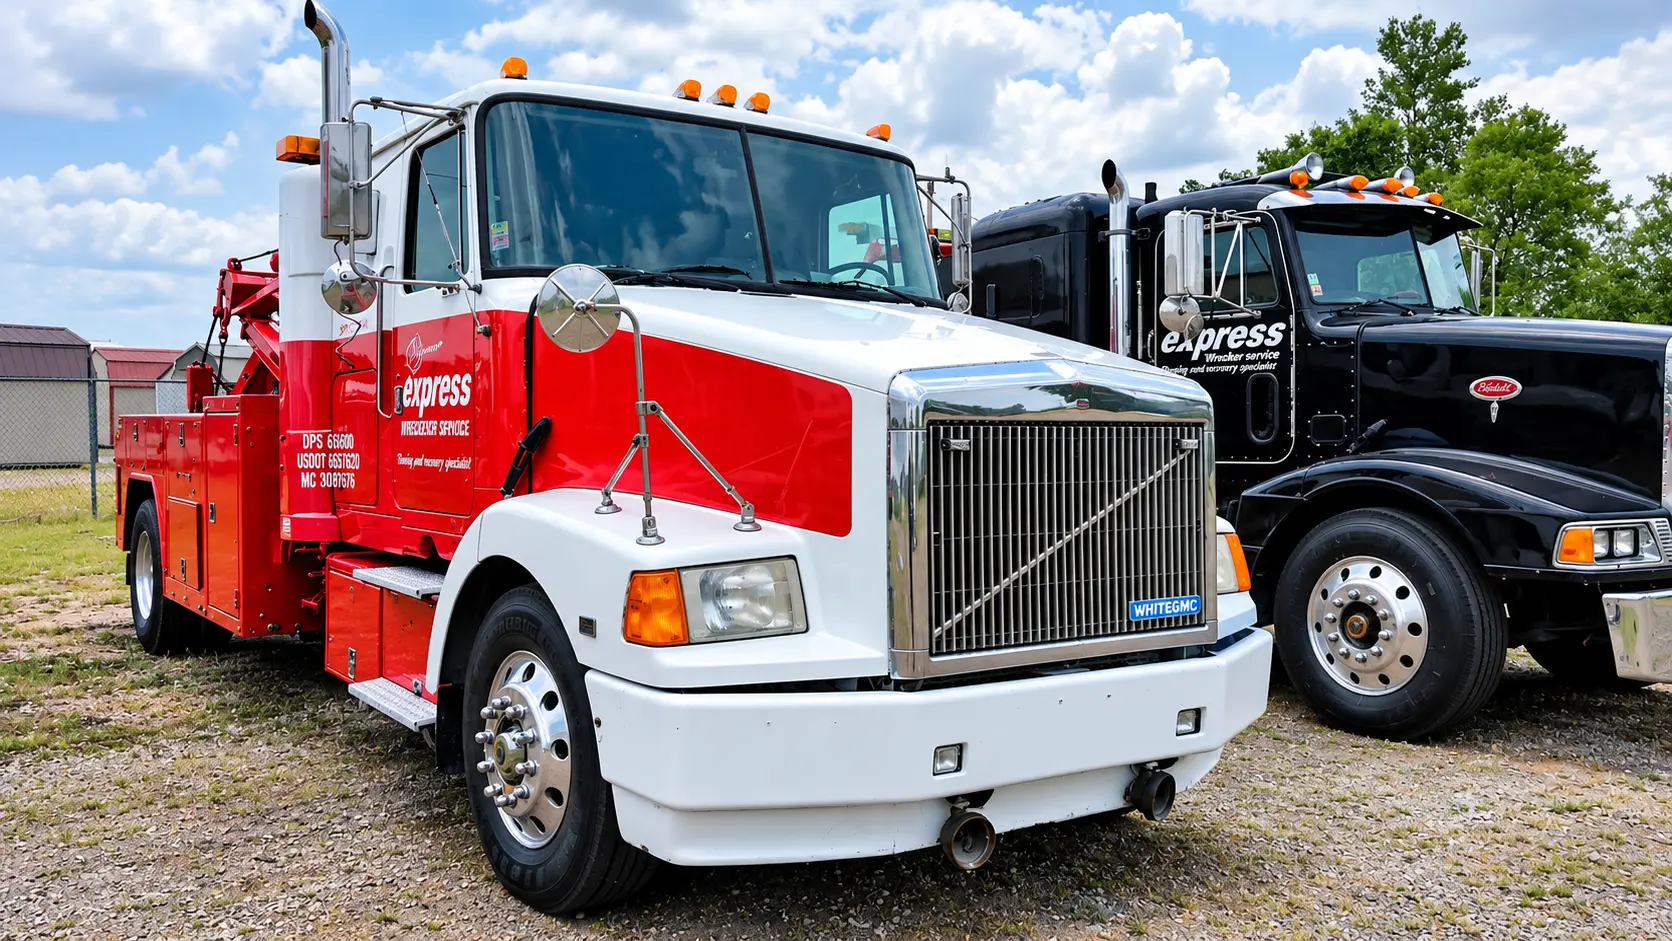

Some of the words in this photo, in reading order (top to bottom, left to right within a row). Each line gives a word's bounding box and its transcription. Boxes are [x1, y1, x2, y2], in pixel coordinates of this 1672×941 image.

[402, 373, 472, 418] express
[302, 433, 323, 450] DPS
[297, 452, 326, 469] USDOT
[301, 472, 317, 488] MC
[1134, 600, 1198, 617] WHITEGMC
